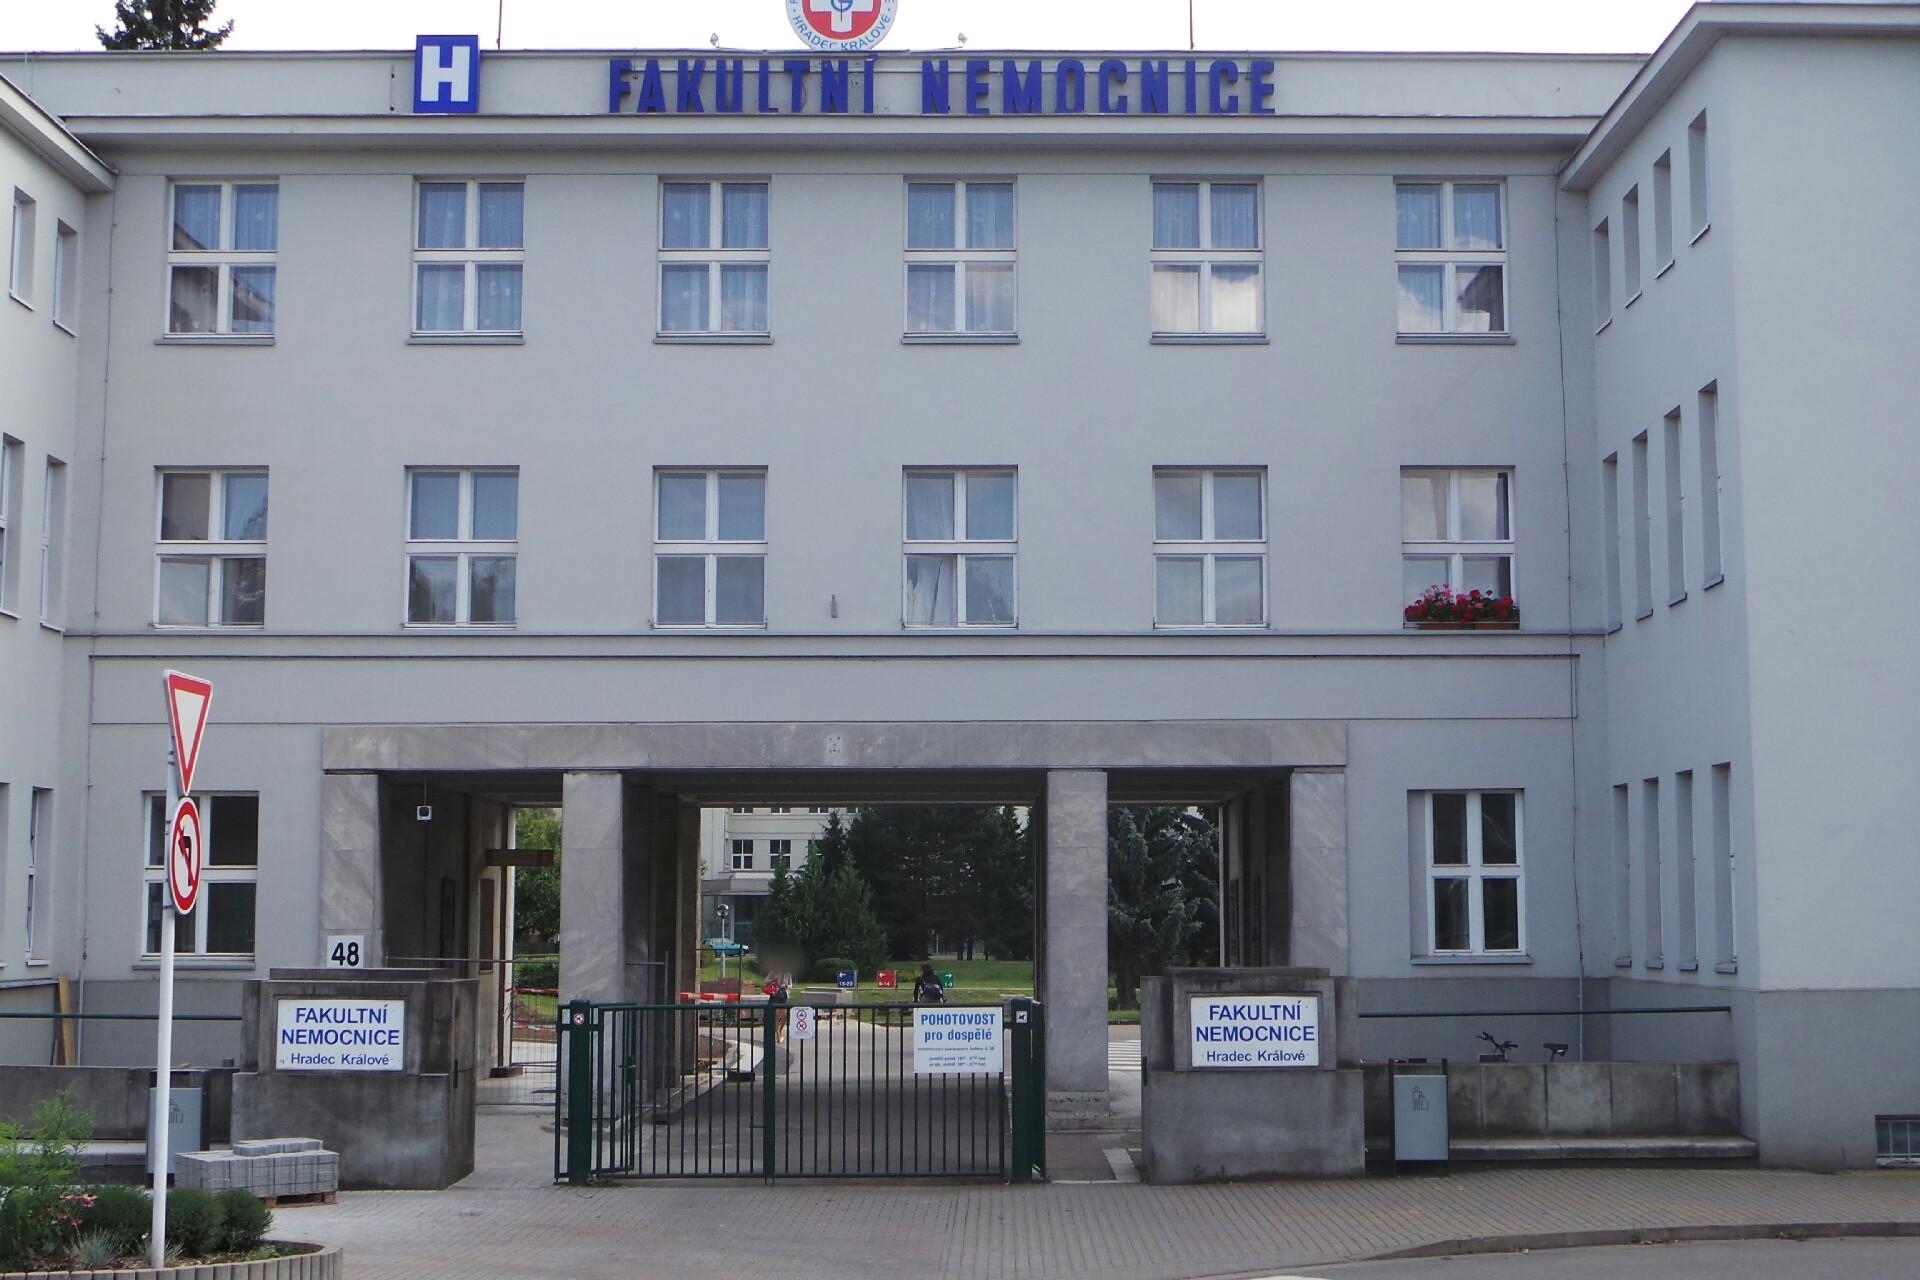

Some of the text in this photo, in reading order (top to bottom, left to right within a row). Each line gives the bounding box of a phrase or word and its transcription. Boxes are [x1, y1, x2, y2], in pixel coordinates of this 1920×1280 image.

[420, 45, 470, 103] H
[609, 54, 1276, 115] FAKULTNÍ NEMOCNICE
[331, 941, 360, 967] 48
[295, 1004, 388, 1024] FAKULTNÍ
[1209, 1000, 1302, 1021] FAKULTNÍ
[921, 1013, 996, 1026] POHOTOVOST
[281, 1029, 400, 1046] NEMOCNICE
[924, 1028, 992, 1043] pro dospělé
[1196, 1025, 1316, 1042] NEMOCNICE
[291, 1053, 389, 1066] Hradec Králové
[1206, 1050, 1306, 1062] Hradec Králové
